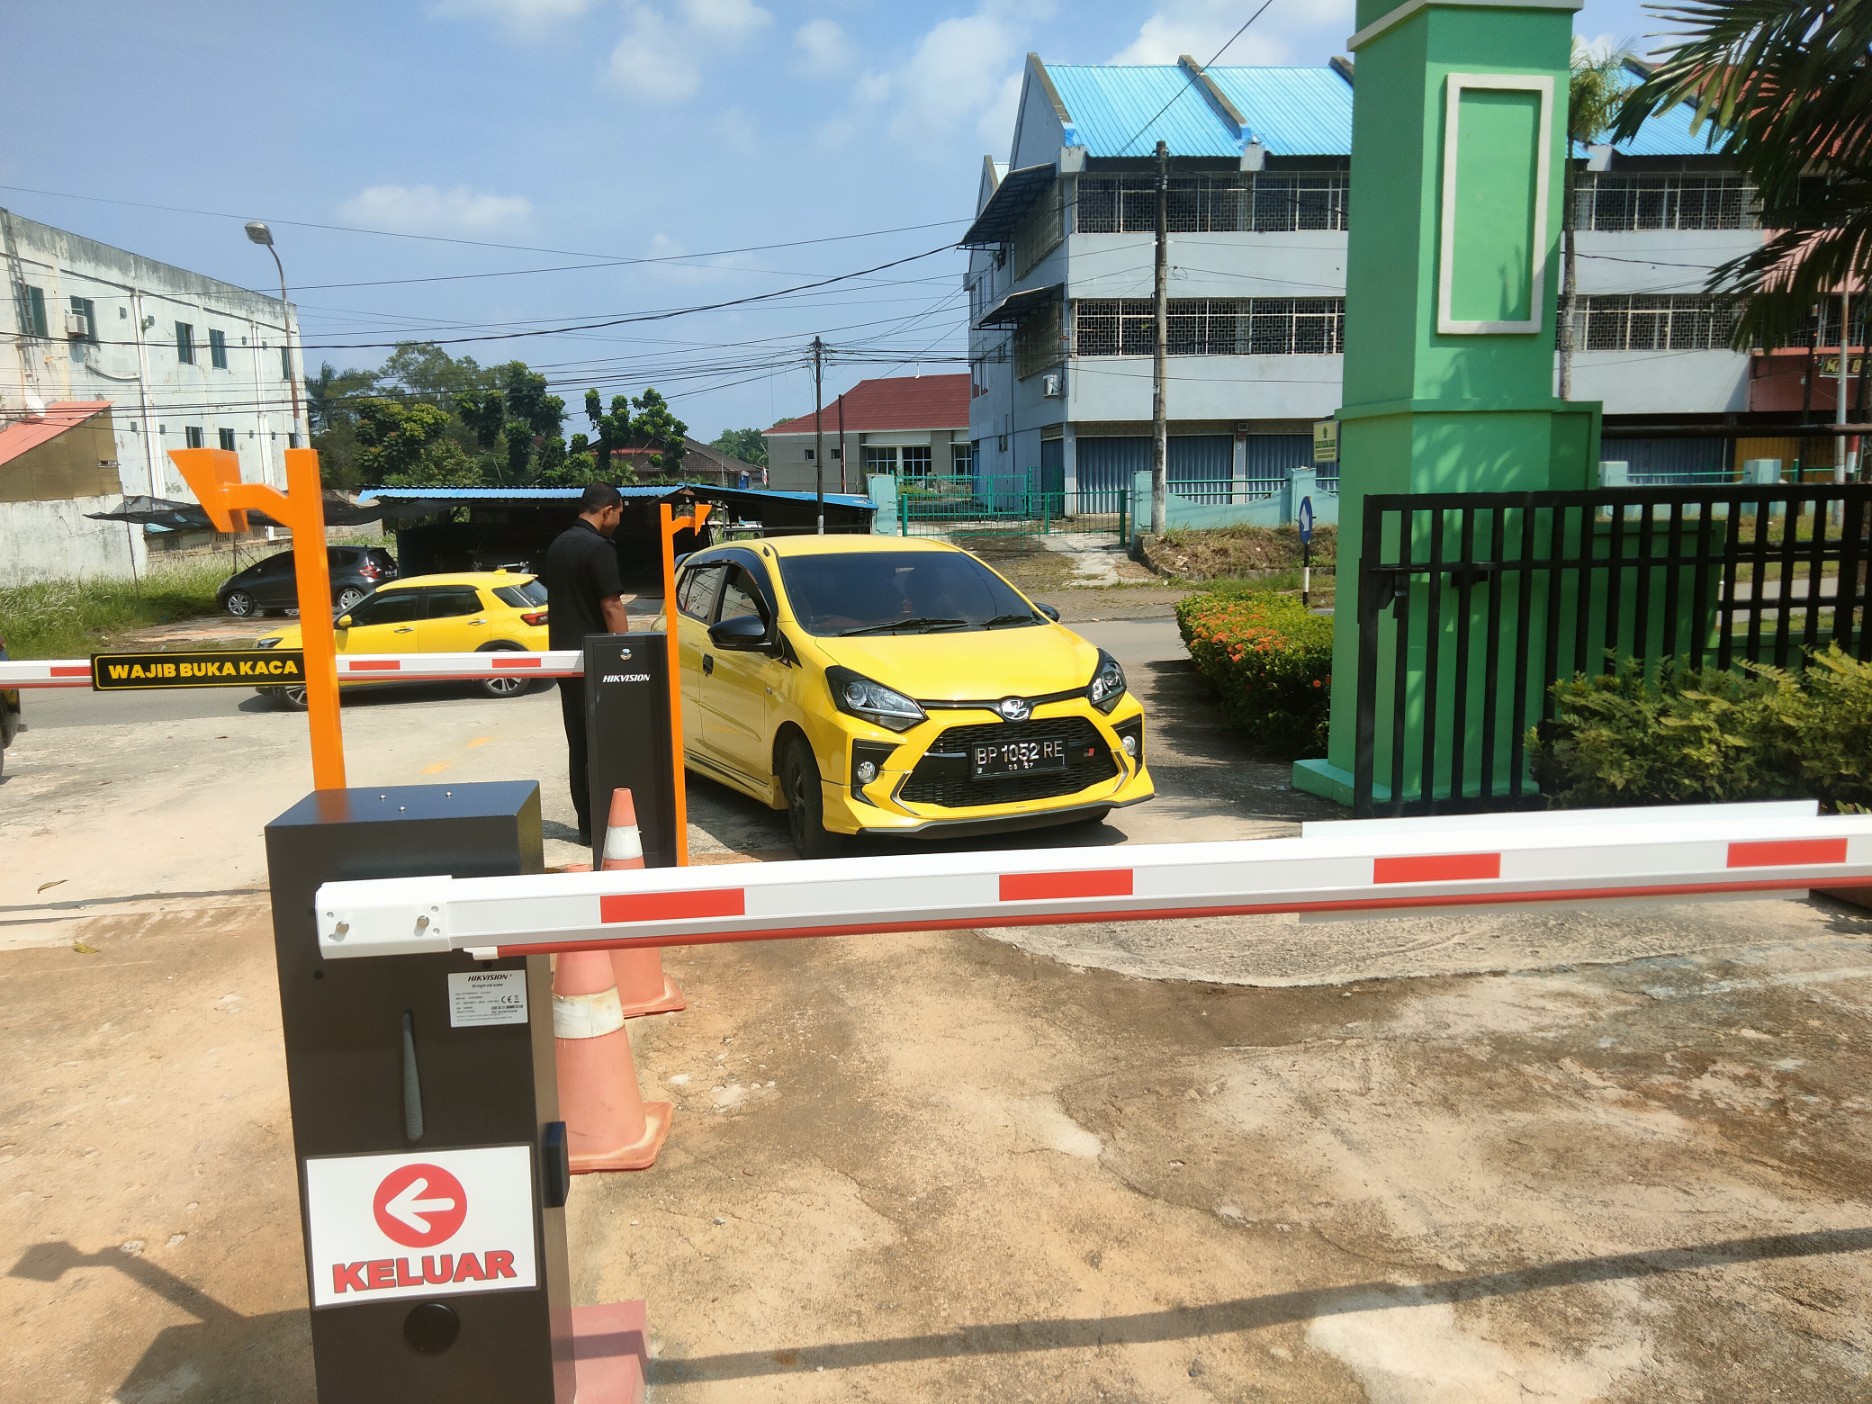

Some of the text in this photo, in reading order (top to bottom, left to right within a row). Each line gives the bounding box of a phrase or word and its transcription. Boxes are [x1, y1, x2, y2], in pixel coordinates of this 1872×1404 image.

[108, 660, 299, 679] WAJIB BUKA KACA
[602, 673, 651, 683] HIKVISION
[977, 746, 998, 765] BP
[1001, 743, 1040, 763] 1052
[1043, 740, 1063, 759] RE
[467, 973, 508, 982] HIKVISION
[332, 1249, 518, 1294] KELUAR
